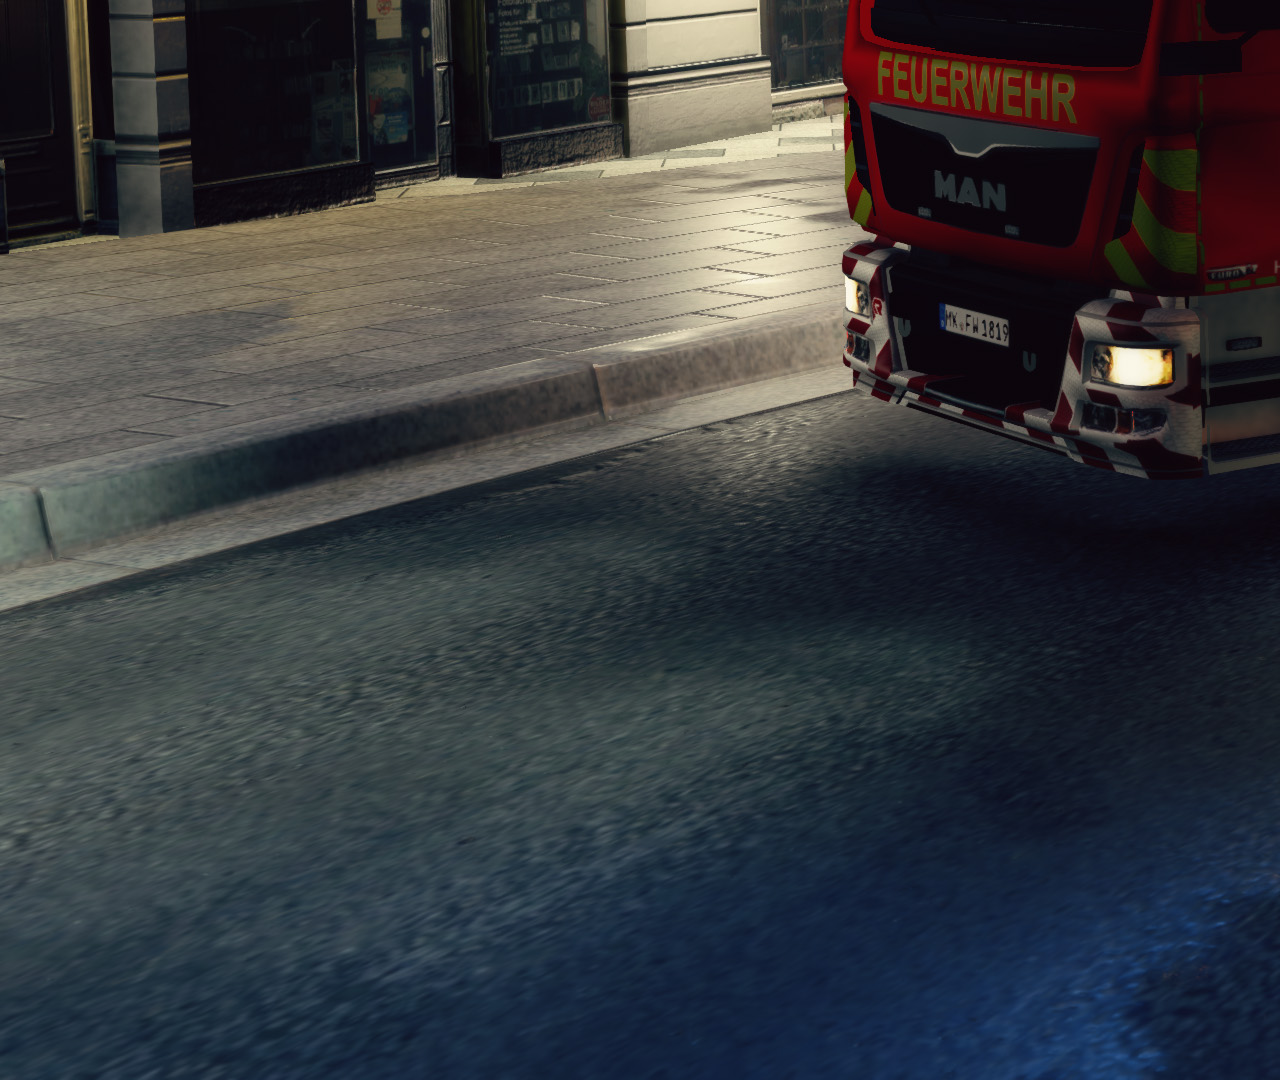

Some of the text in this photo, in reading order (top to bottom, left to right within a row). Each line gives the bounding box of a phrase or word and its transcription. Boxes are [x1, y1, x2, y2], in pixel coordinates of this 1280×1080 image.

[877, 50, 1078, 124] FEUERWEHR
[934, 169, 1007, 212] MAN
[966, 314, 979, 334] FW
[982, 319, 1009, 342] 1819
